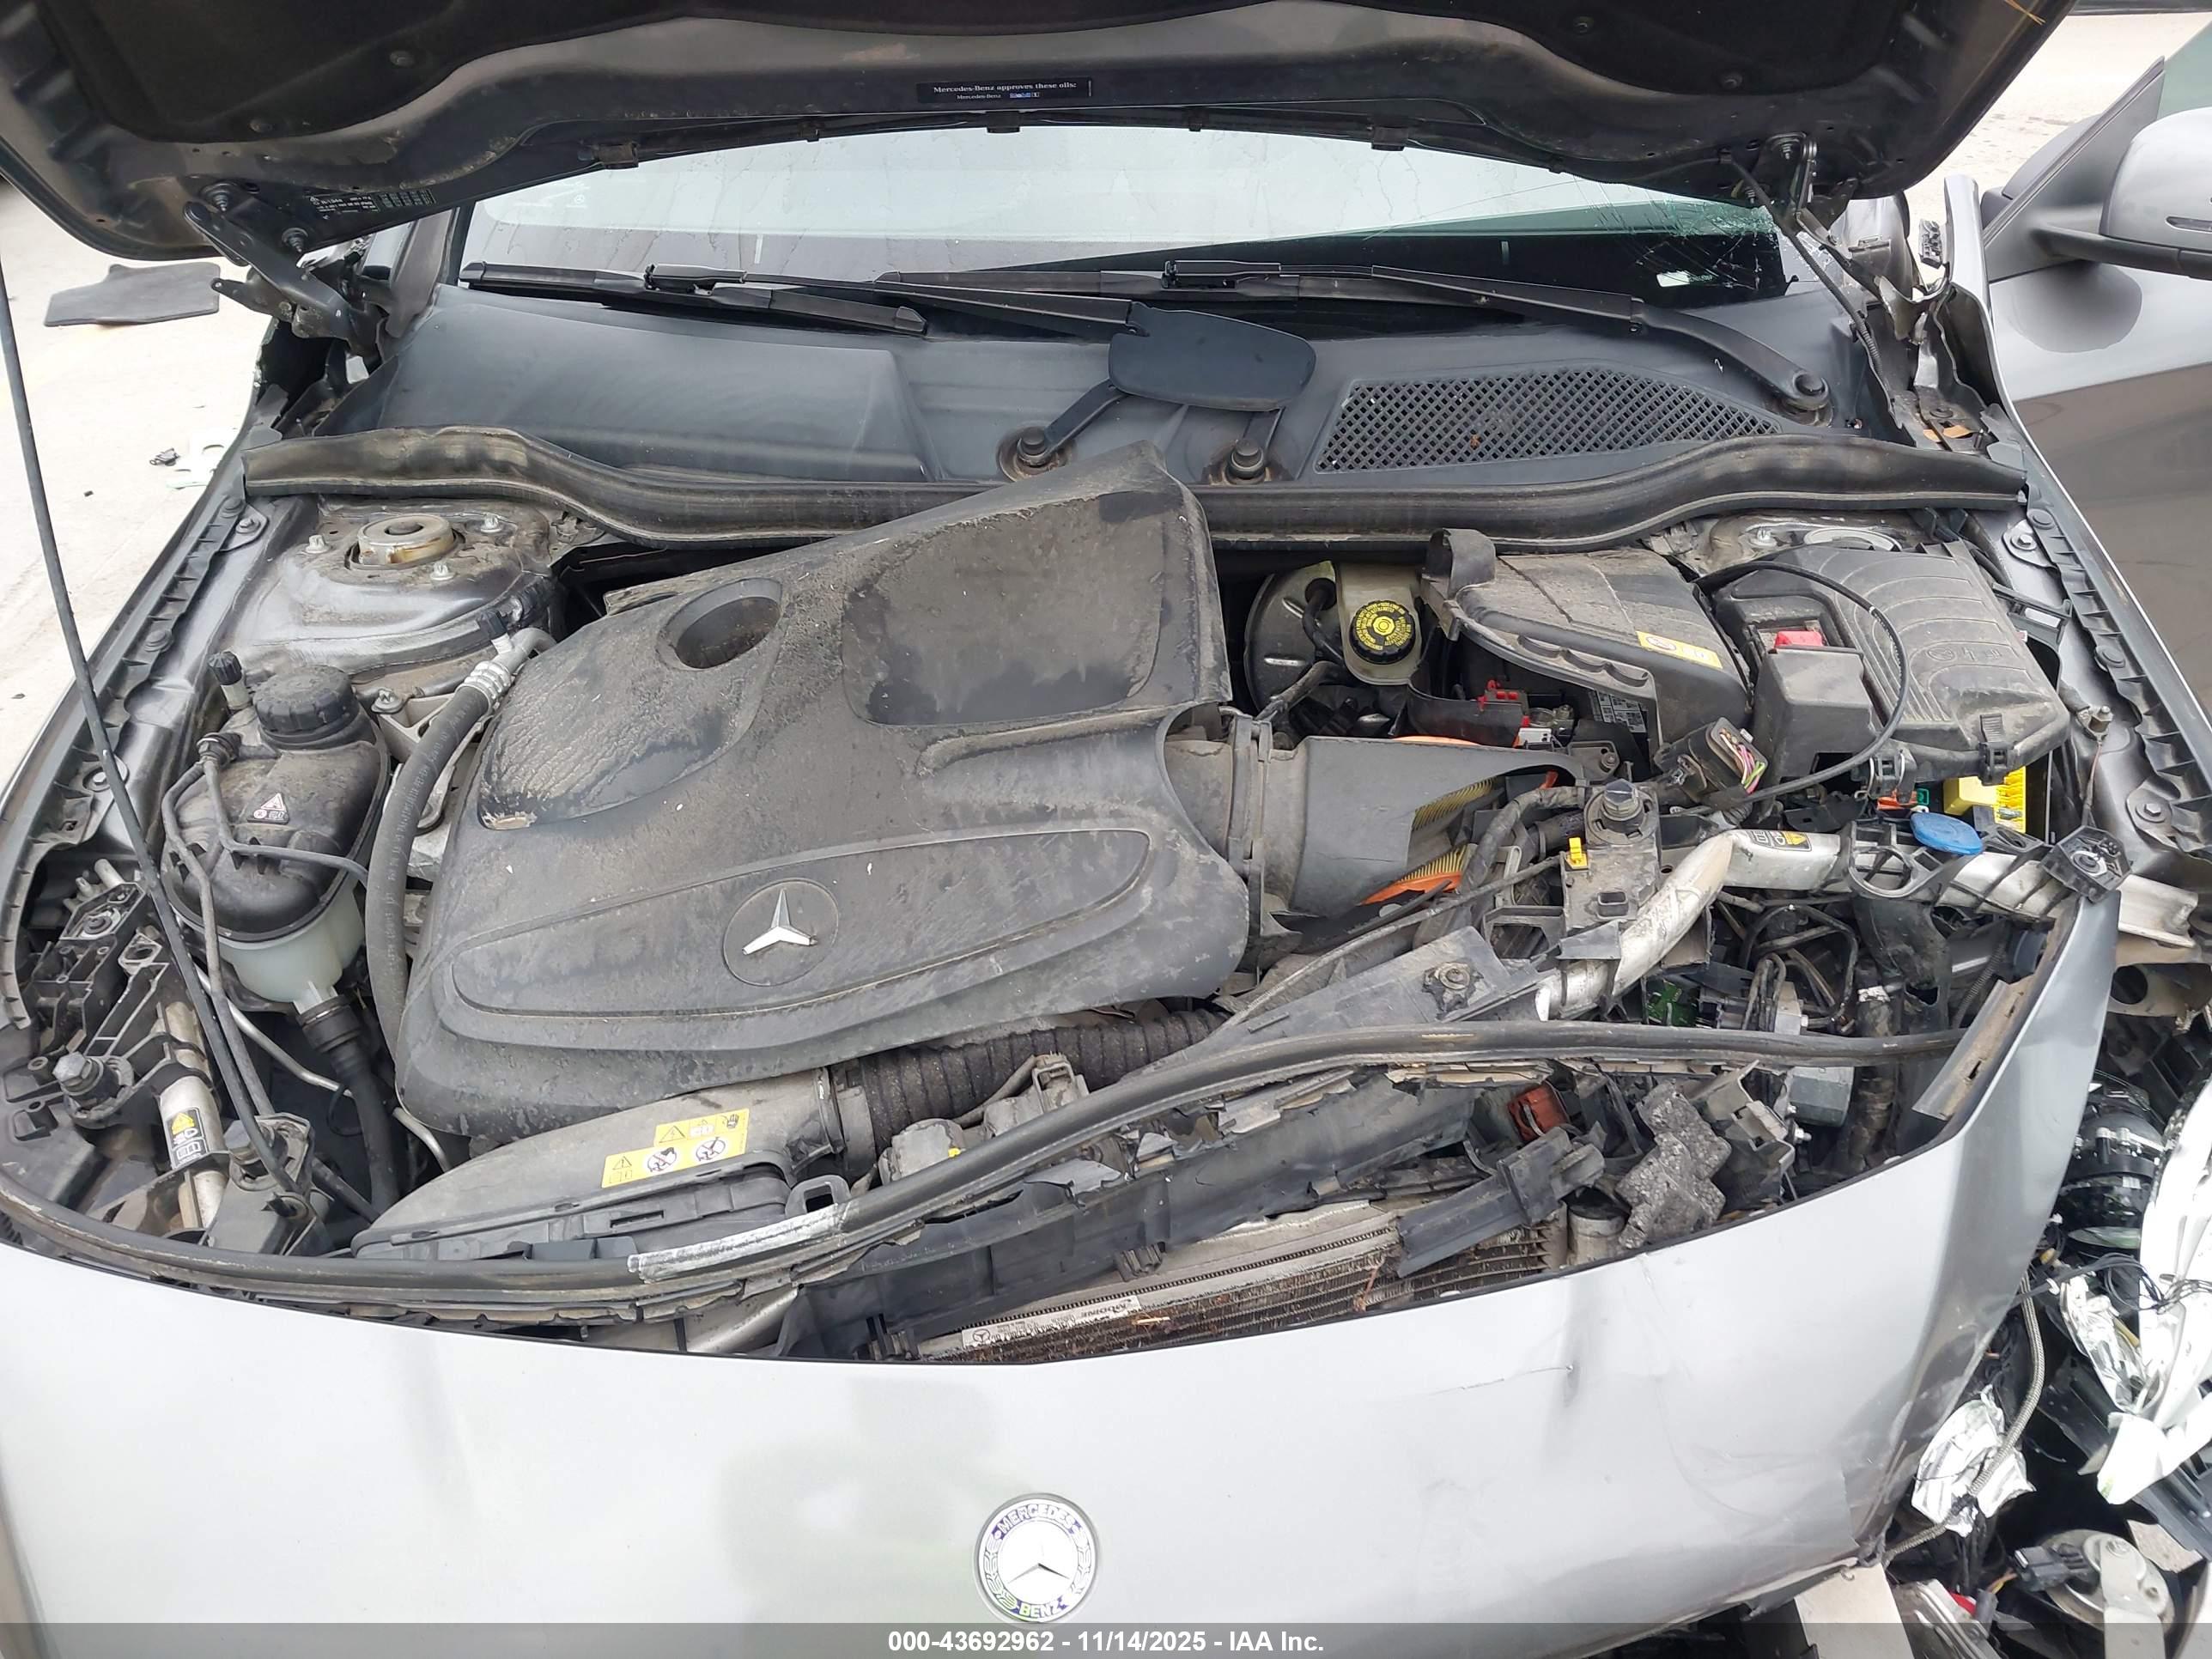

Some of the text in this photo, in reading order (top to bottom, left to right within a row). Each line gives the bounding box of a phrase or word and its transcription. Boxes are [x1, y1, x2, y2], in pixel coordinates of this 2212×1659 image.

[933, 84, 994, 94] Mercedes-Benz
[998, 1504, 1076, 1534] MERCEDES
[1018, 1601, 1060, 1618] BENZ
